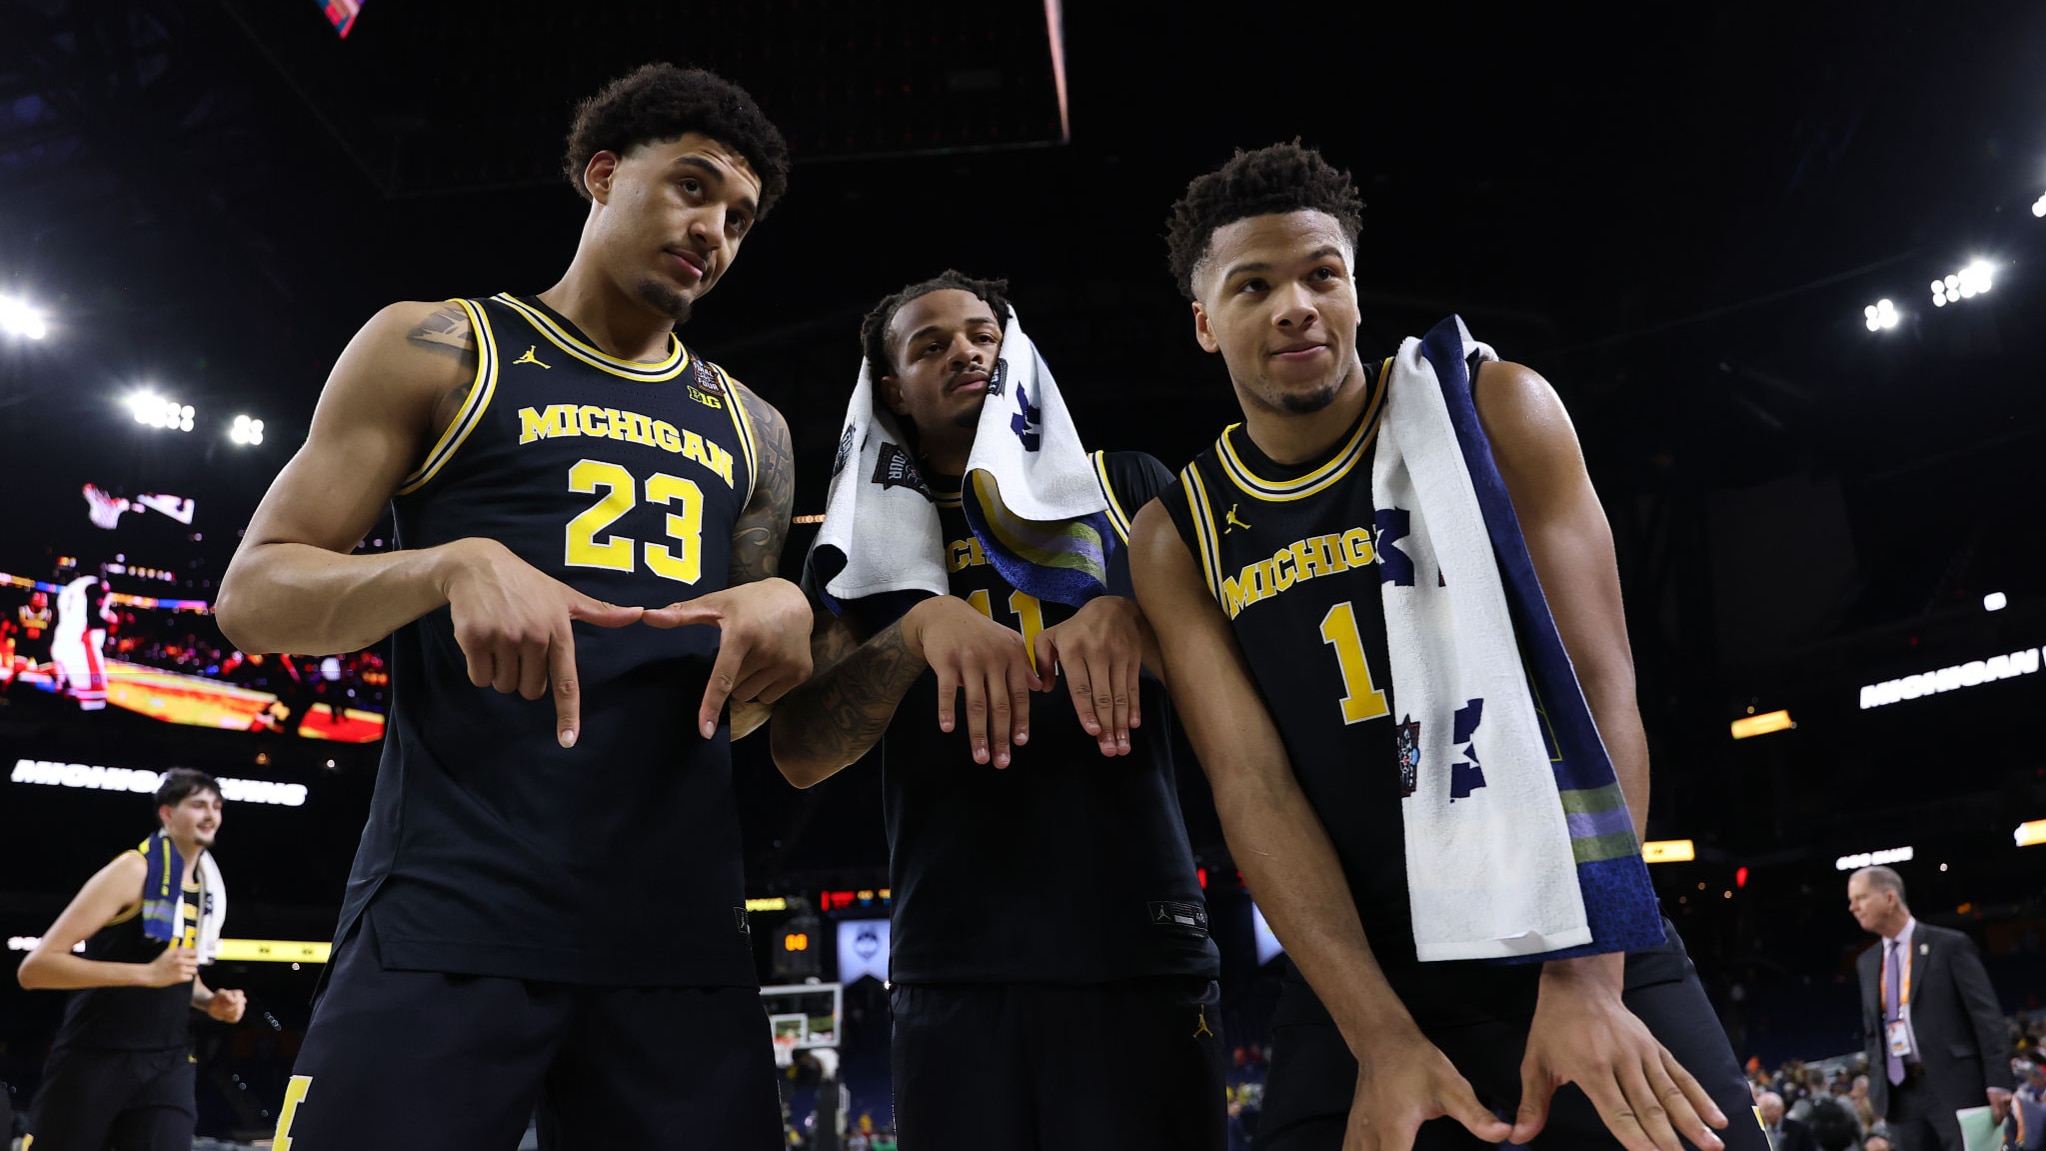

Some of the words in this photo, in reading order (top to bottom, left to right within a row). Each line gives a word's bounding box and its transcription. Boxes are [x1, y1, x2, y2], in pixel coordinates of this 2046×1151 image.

[518, 404, 734, 490] MICHIGAN
[564, 458, 704, 586] 23
[1222, 524, 1379, 621] MICHIG
[1319, 600, 1391, 726] 1
[10, 758, 168, 794] MICHIG
